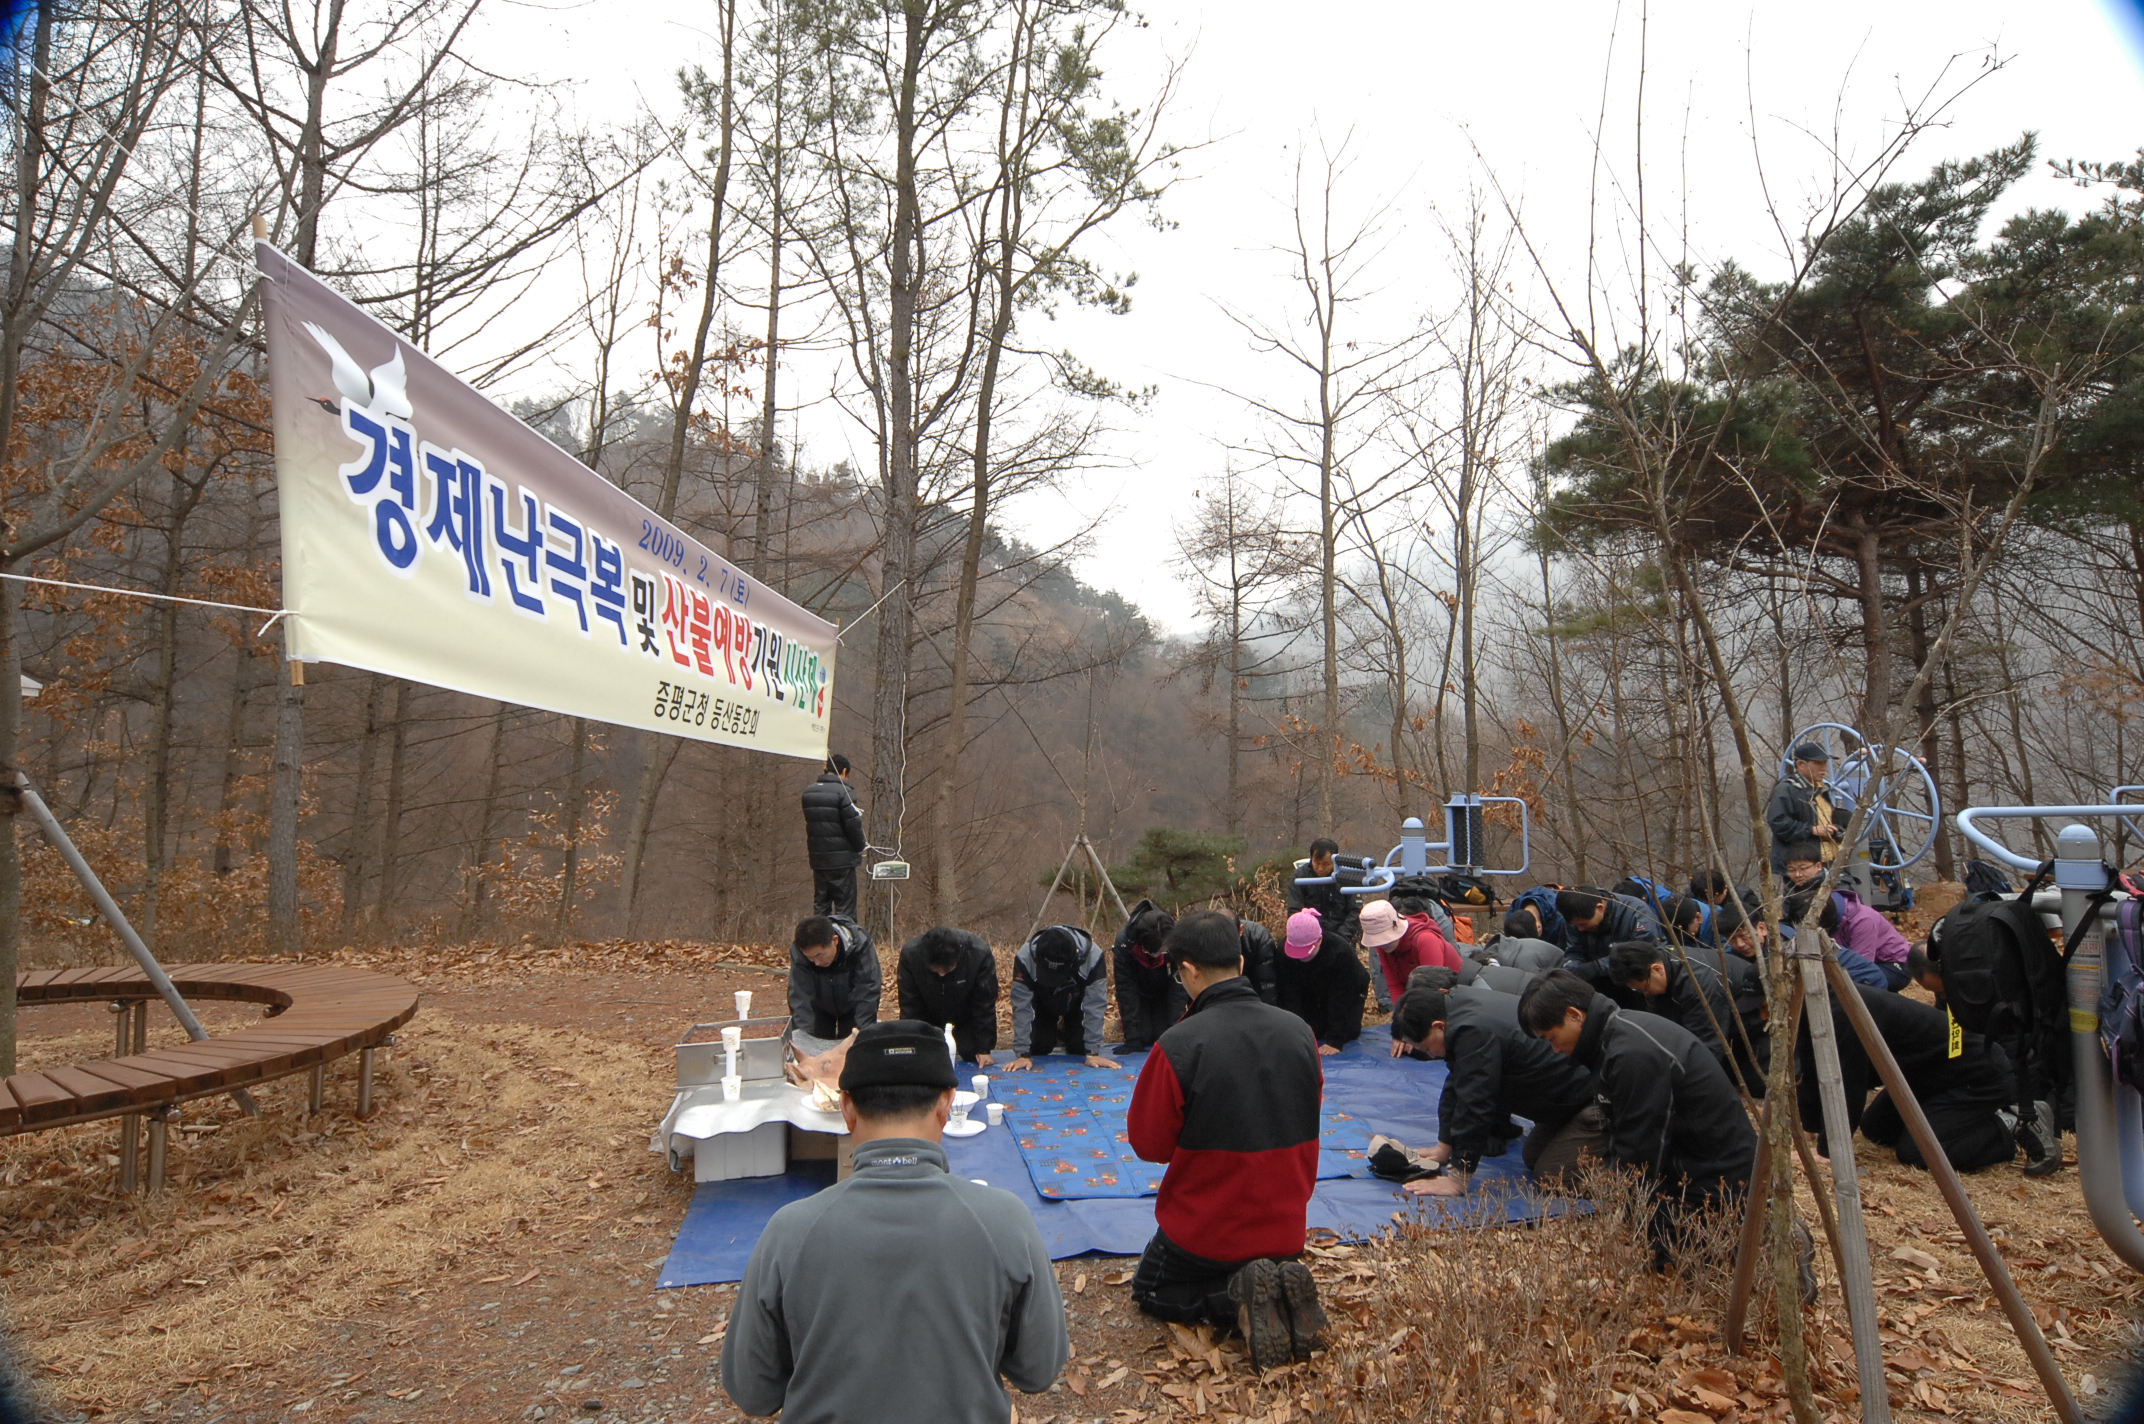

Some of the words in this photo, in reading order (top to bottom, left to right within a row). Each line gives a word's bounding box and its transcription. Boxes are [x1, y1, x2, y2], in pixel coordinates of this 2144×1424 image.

[346, 408, 628, 646] 경제난극복
[631, 575, 660, 657] 및
[638, 518, 687, 576] 2009.
[697, 555, 710, 588] 2.
[654, 680, 709, 727] 증평군청
[710, 698, 760, 737] 등산동호회
[870, 1157, 892, 1167] mont
[902, 1156, 918, 1165] bell
